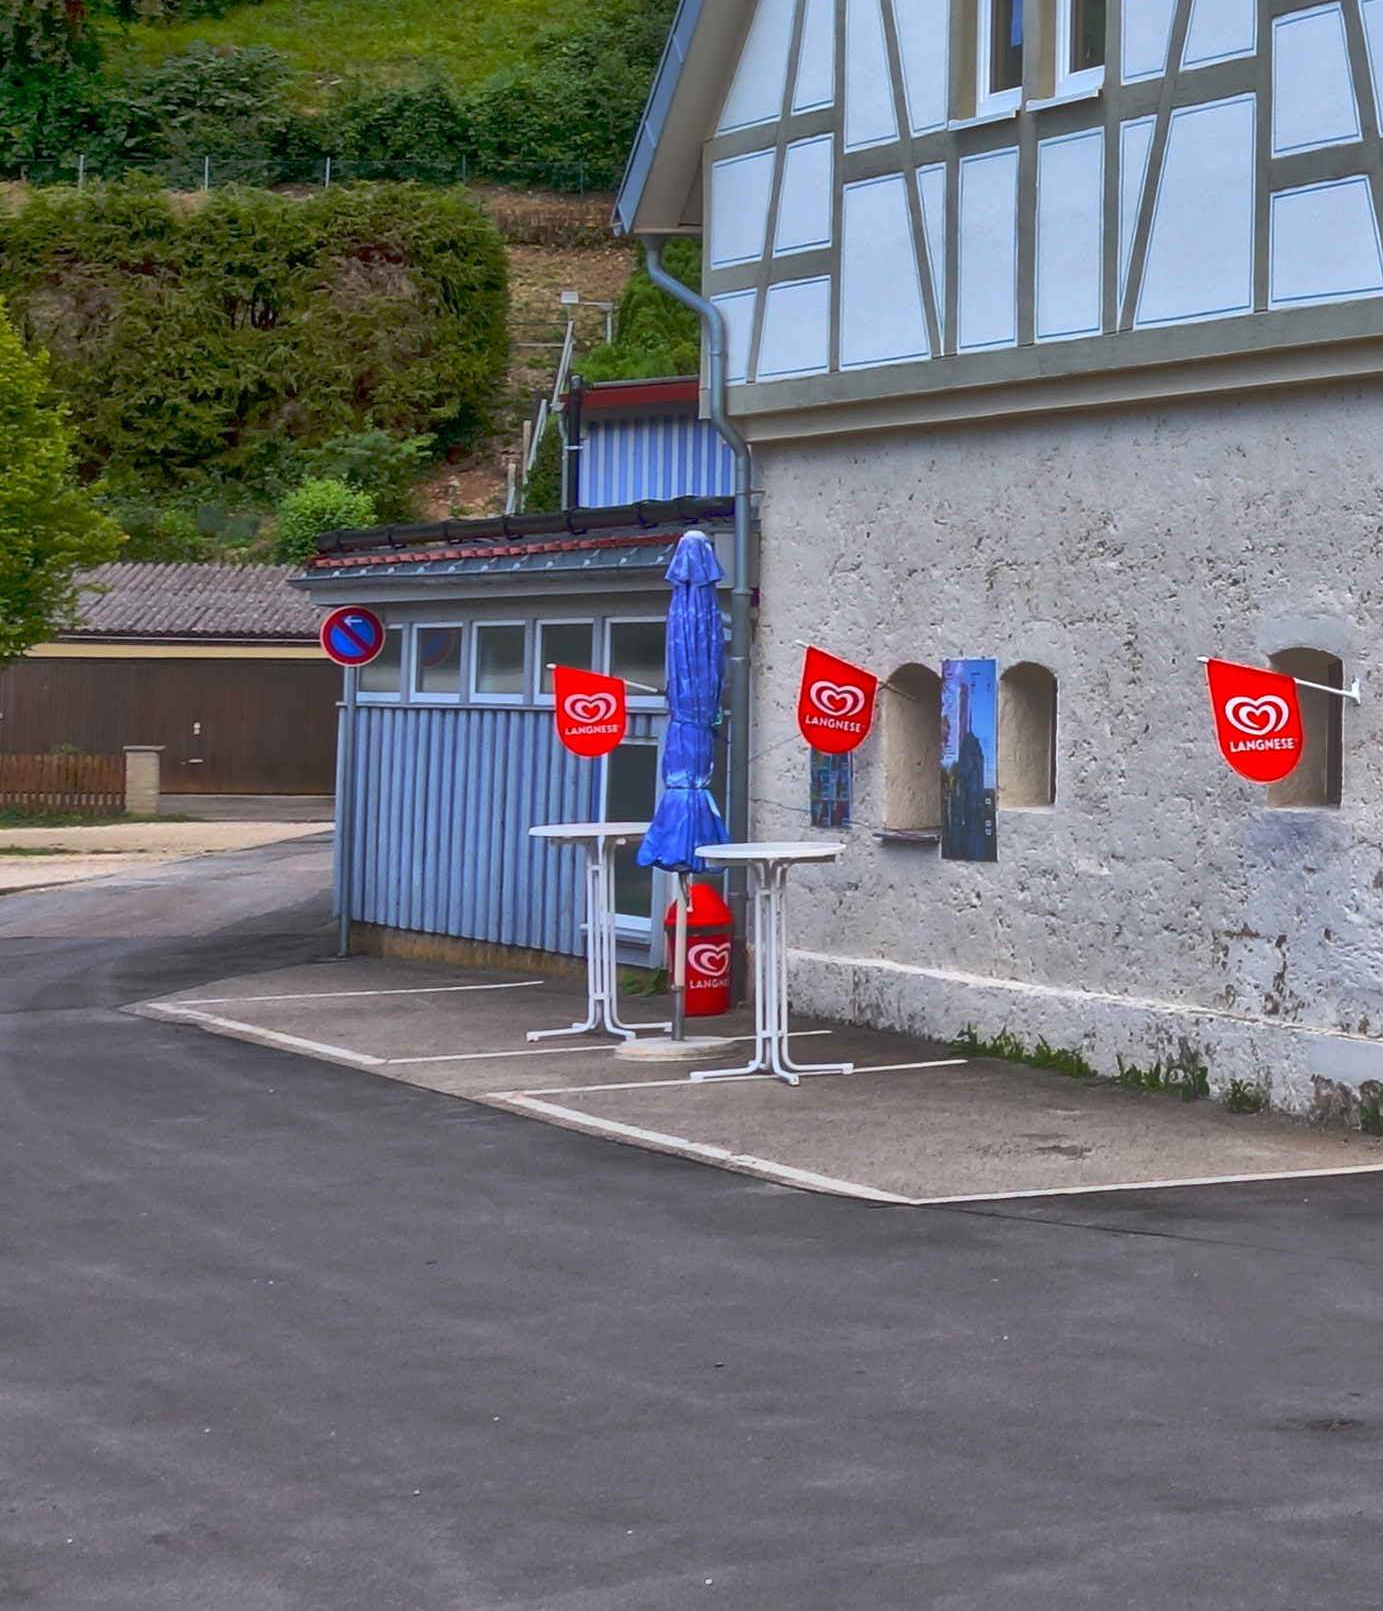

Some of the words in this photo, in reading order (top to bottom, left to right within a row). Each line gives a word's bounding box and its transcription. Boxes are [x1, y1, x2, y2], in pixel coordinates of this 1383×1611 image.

[565, 724, 619, 736] LANGNESE
[805, 714, 862, 734] LANGNESE
[1229, 737, 1296, 752] LANGNESE
